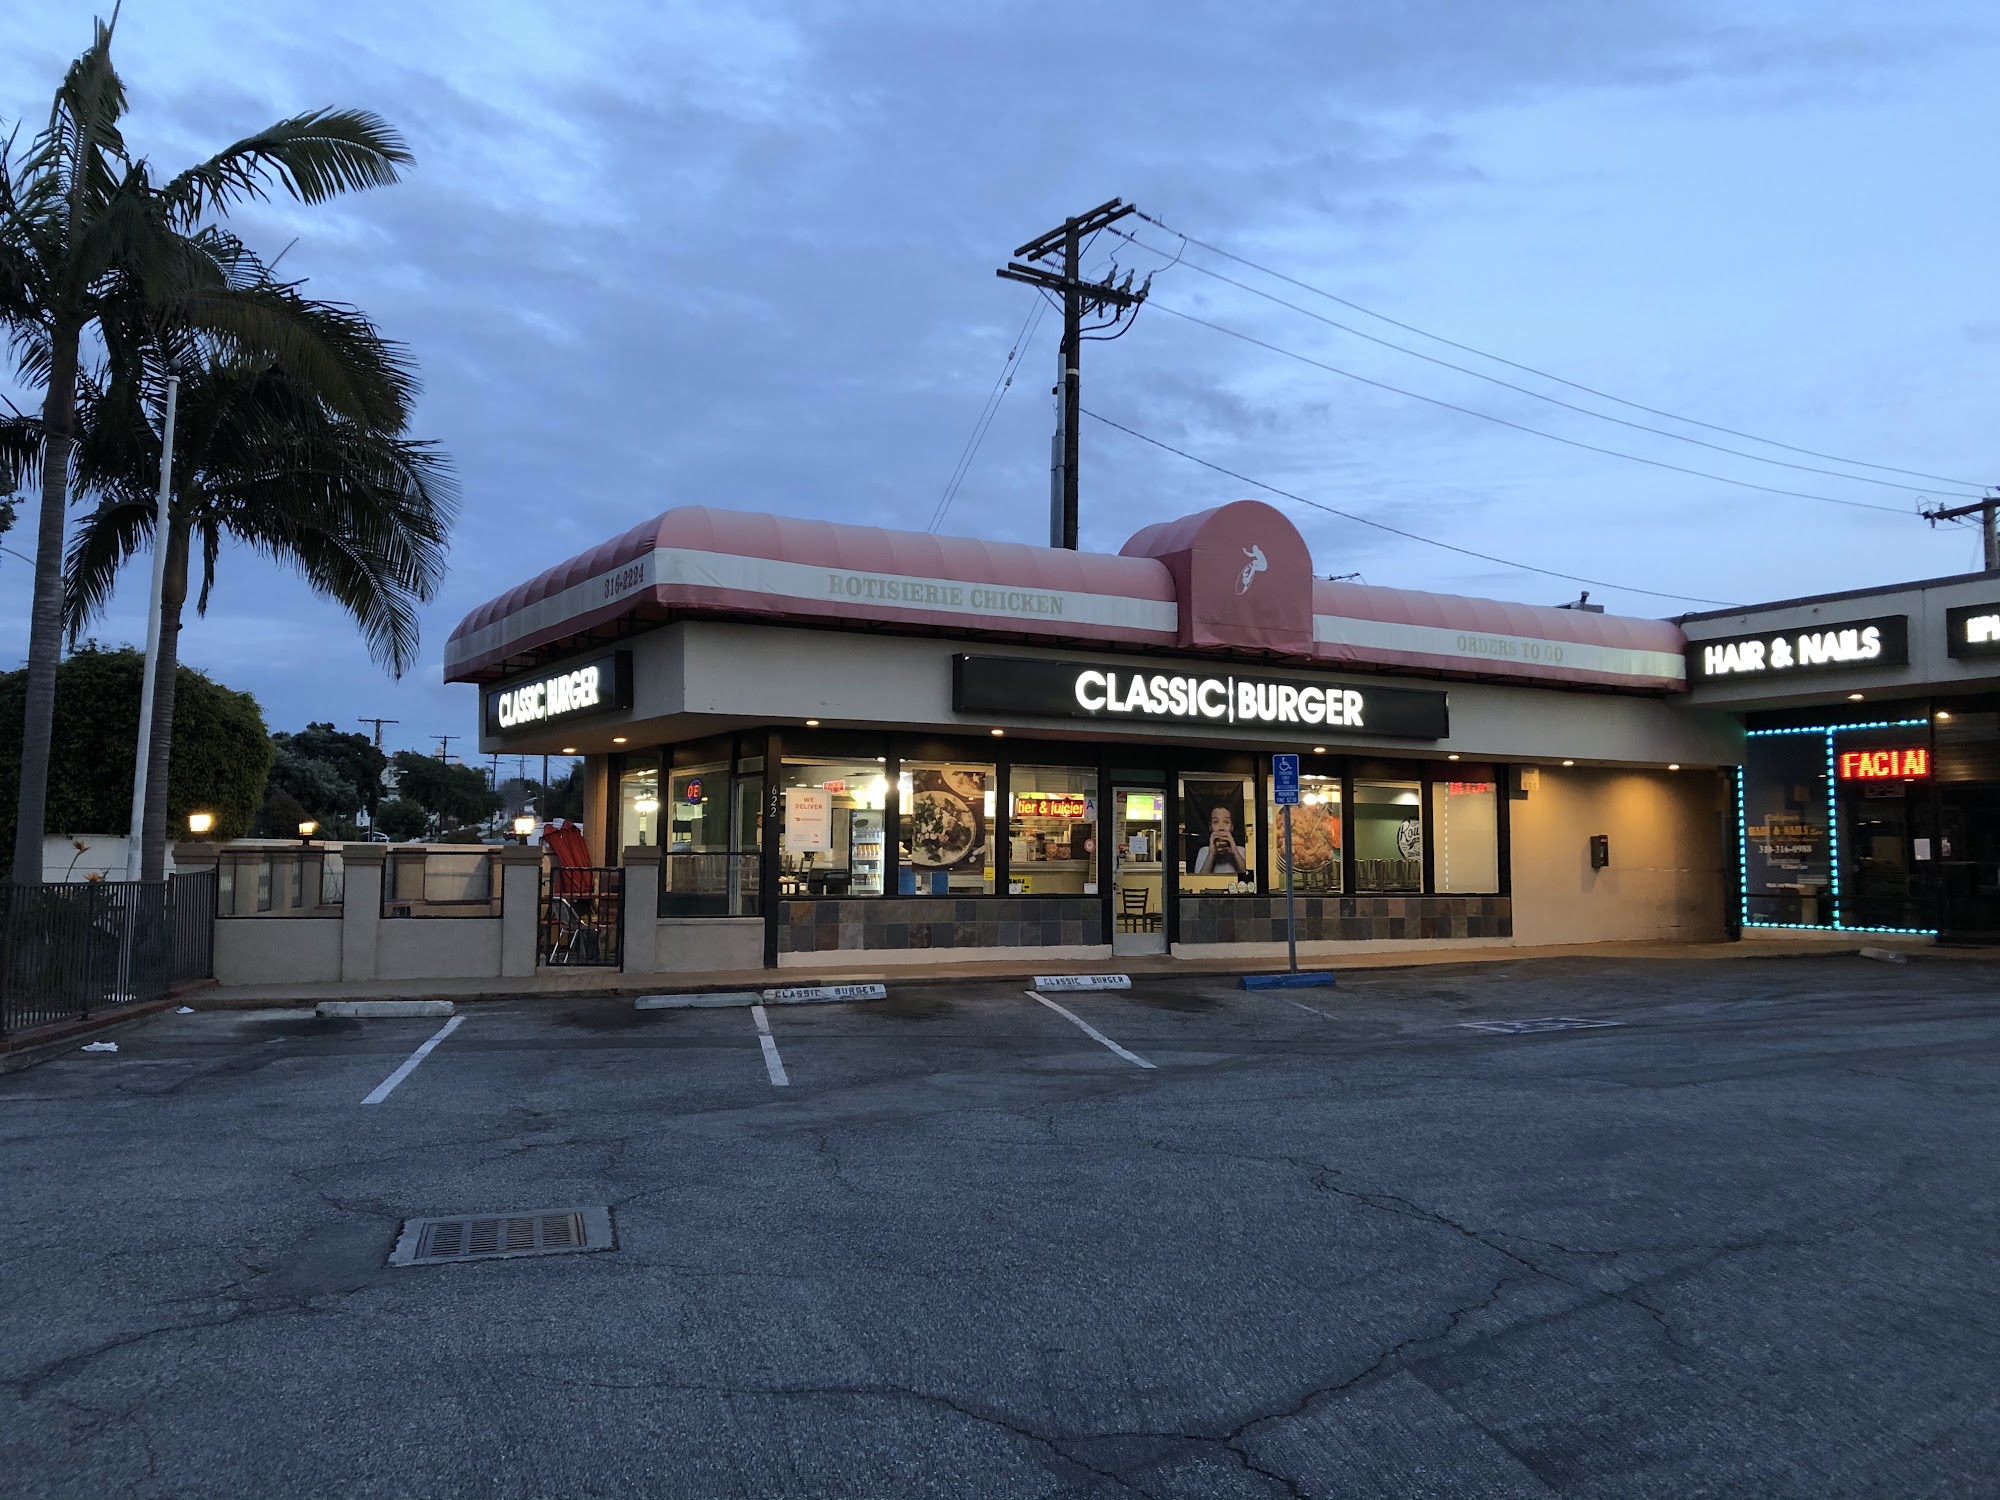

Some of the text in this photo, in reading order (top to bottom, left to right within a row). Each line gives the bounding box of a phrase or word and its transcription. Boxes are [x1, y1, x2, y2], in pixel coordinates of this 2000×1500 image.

[604, 563, 644, 599] 316-2224
[828, 574, 1063, 615] ROTISIERIE CHICKEN
[1456, 635, 1563, 661] ORDERS TO GO
[1705, 626, 1880, 674] HAIR & NAILS
[499, 666, 599, 728] CLASSIC BURGER
[1075, 670, 1364, 727] CLASSIC BURGER
[1039, 801, 1048, 813] &
[1051, 800, 1084, 816] juicier
[1086, 799, 1094, 809] A
[775, 985, 876, 998] CLASSIC BURGER
[1043, 976, 1124, 986] CLASSIC BURGER
